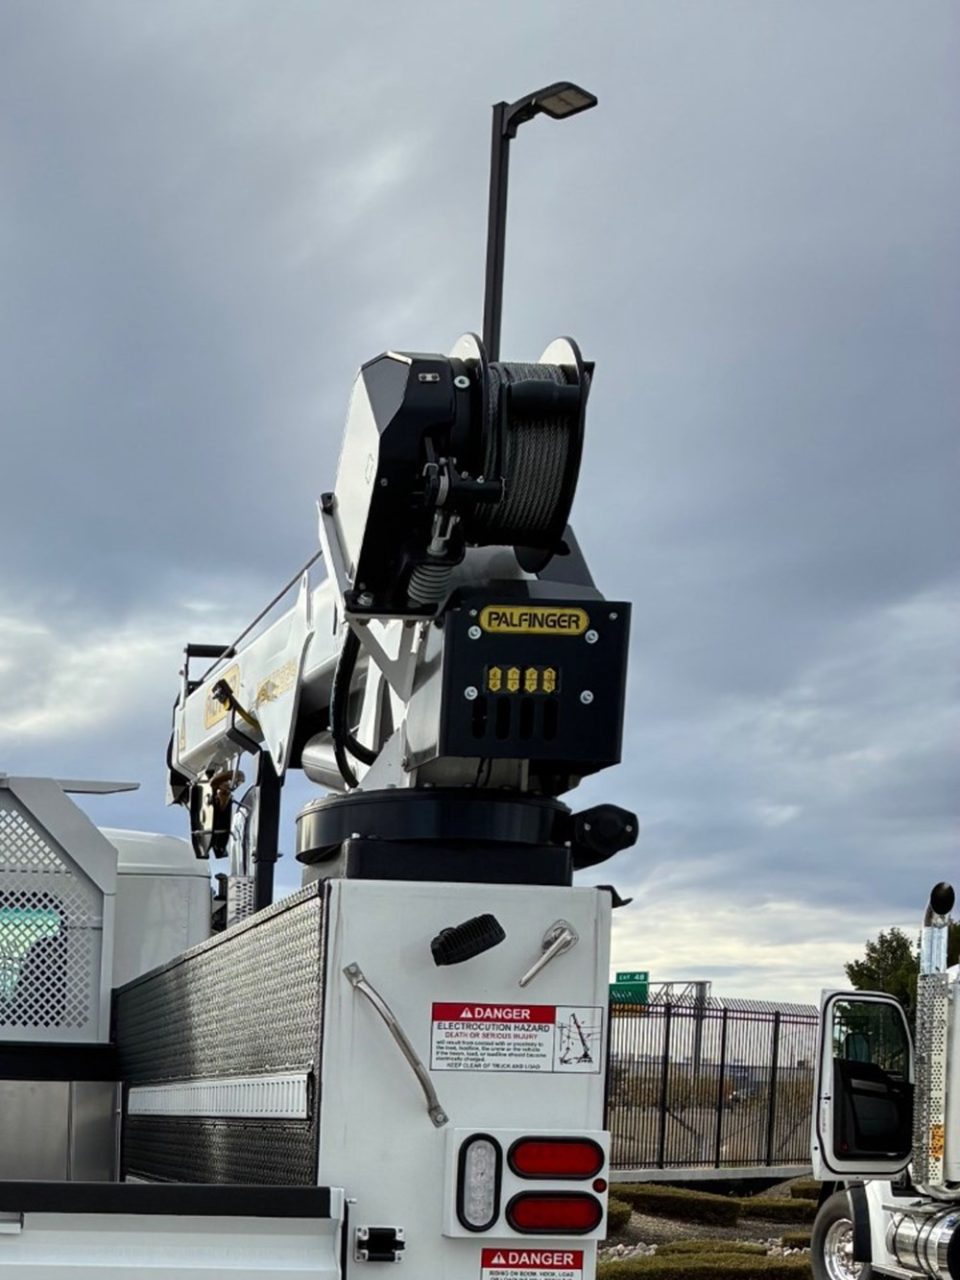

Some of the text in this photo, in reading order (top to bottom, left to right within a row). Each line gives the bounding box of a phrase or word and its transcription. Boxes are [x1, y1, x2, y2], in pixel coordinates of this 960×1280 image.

[487, 612, 580, 629] PALFINGER
[474, 1007, 530, 1020] DANGER
[437, 1022, 550, 1032] ELECTROCUTION HAZARD
[509, 1252, 574, 1266] DANGER
